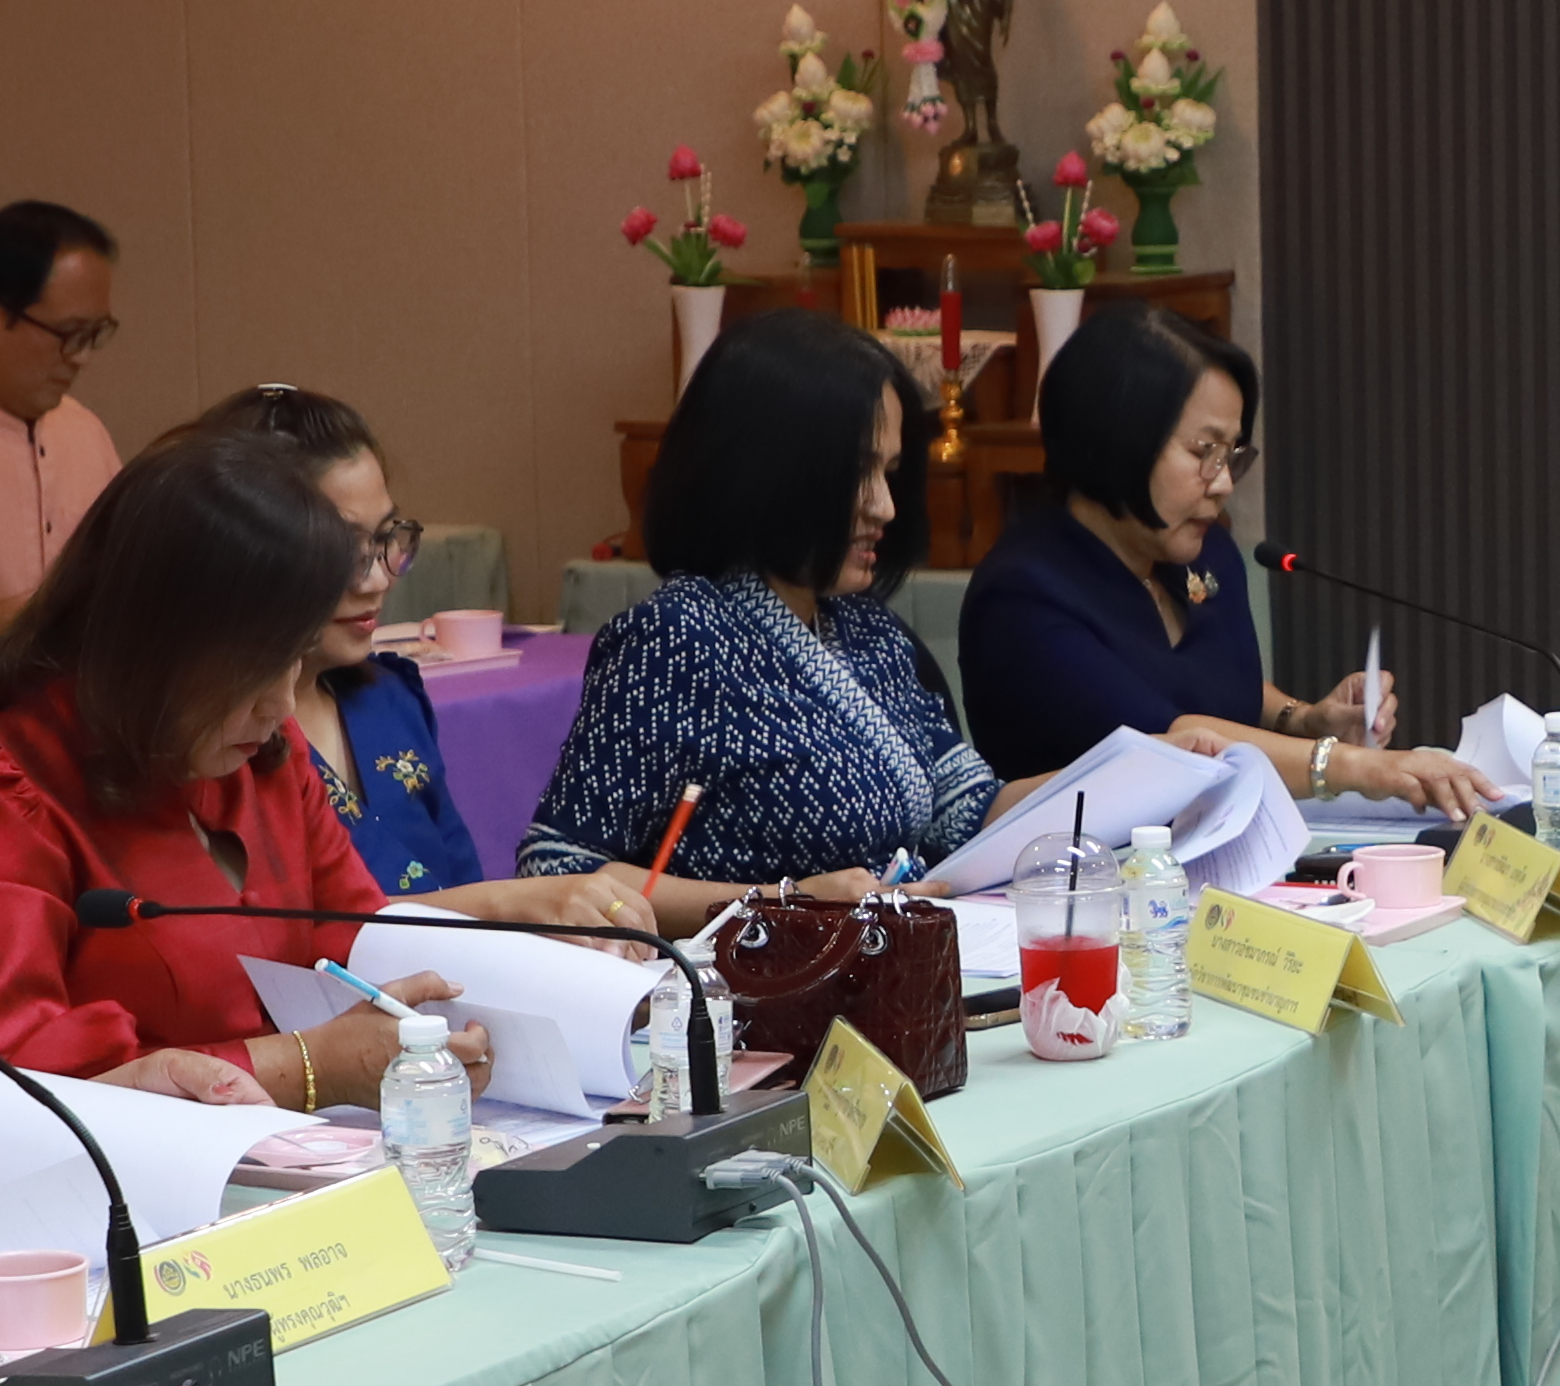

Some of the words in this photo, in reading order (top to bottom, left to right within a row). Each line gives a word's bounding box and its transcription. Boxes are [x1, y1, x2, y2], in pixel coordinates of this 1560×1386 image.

[779, 1115, 806, 1136] NPE
[223, 1262, 292, 1300] นางธนพร
[298, 1242, 348, 1272] พลอาจ
[227, 1338, 266, 1367] NPE
